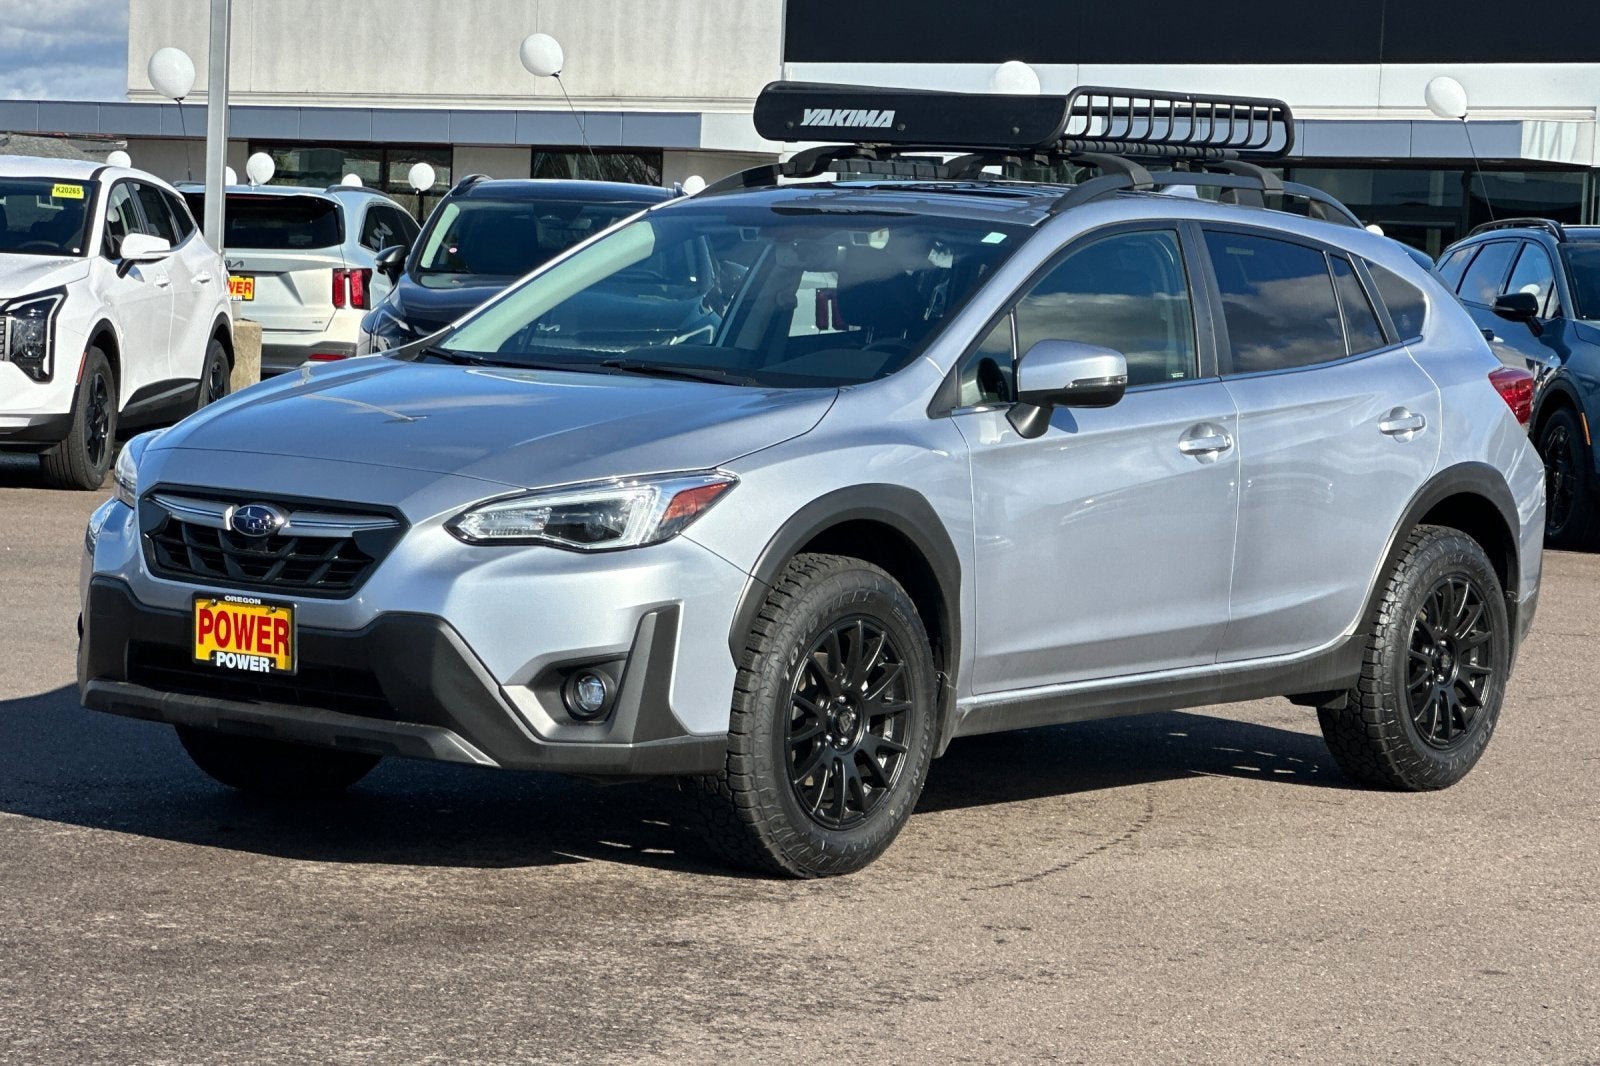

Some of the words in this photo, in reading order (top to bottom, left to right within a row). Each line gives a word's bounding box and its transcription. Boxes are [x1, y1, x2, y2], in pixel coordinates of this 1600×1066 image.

[800, 108, 896, 128] YAKIMA
[55, 186, 81, 194] K20265
[227, 281, 252, 294] WER
[224, 595, 262, 605] OREGON
[198, 608, 290, 656] POWER
[216, 651, 270, 673] POWER
